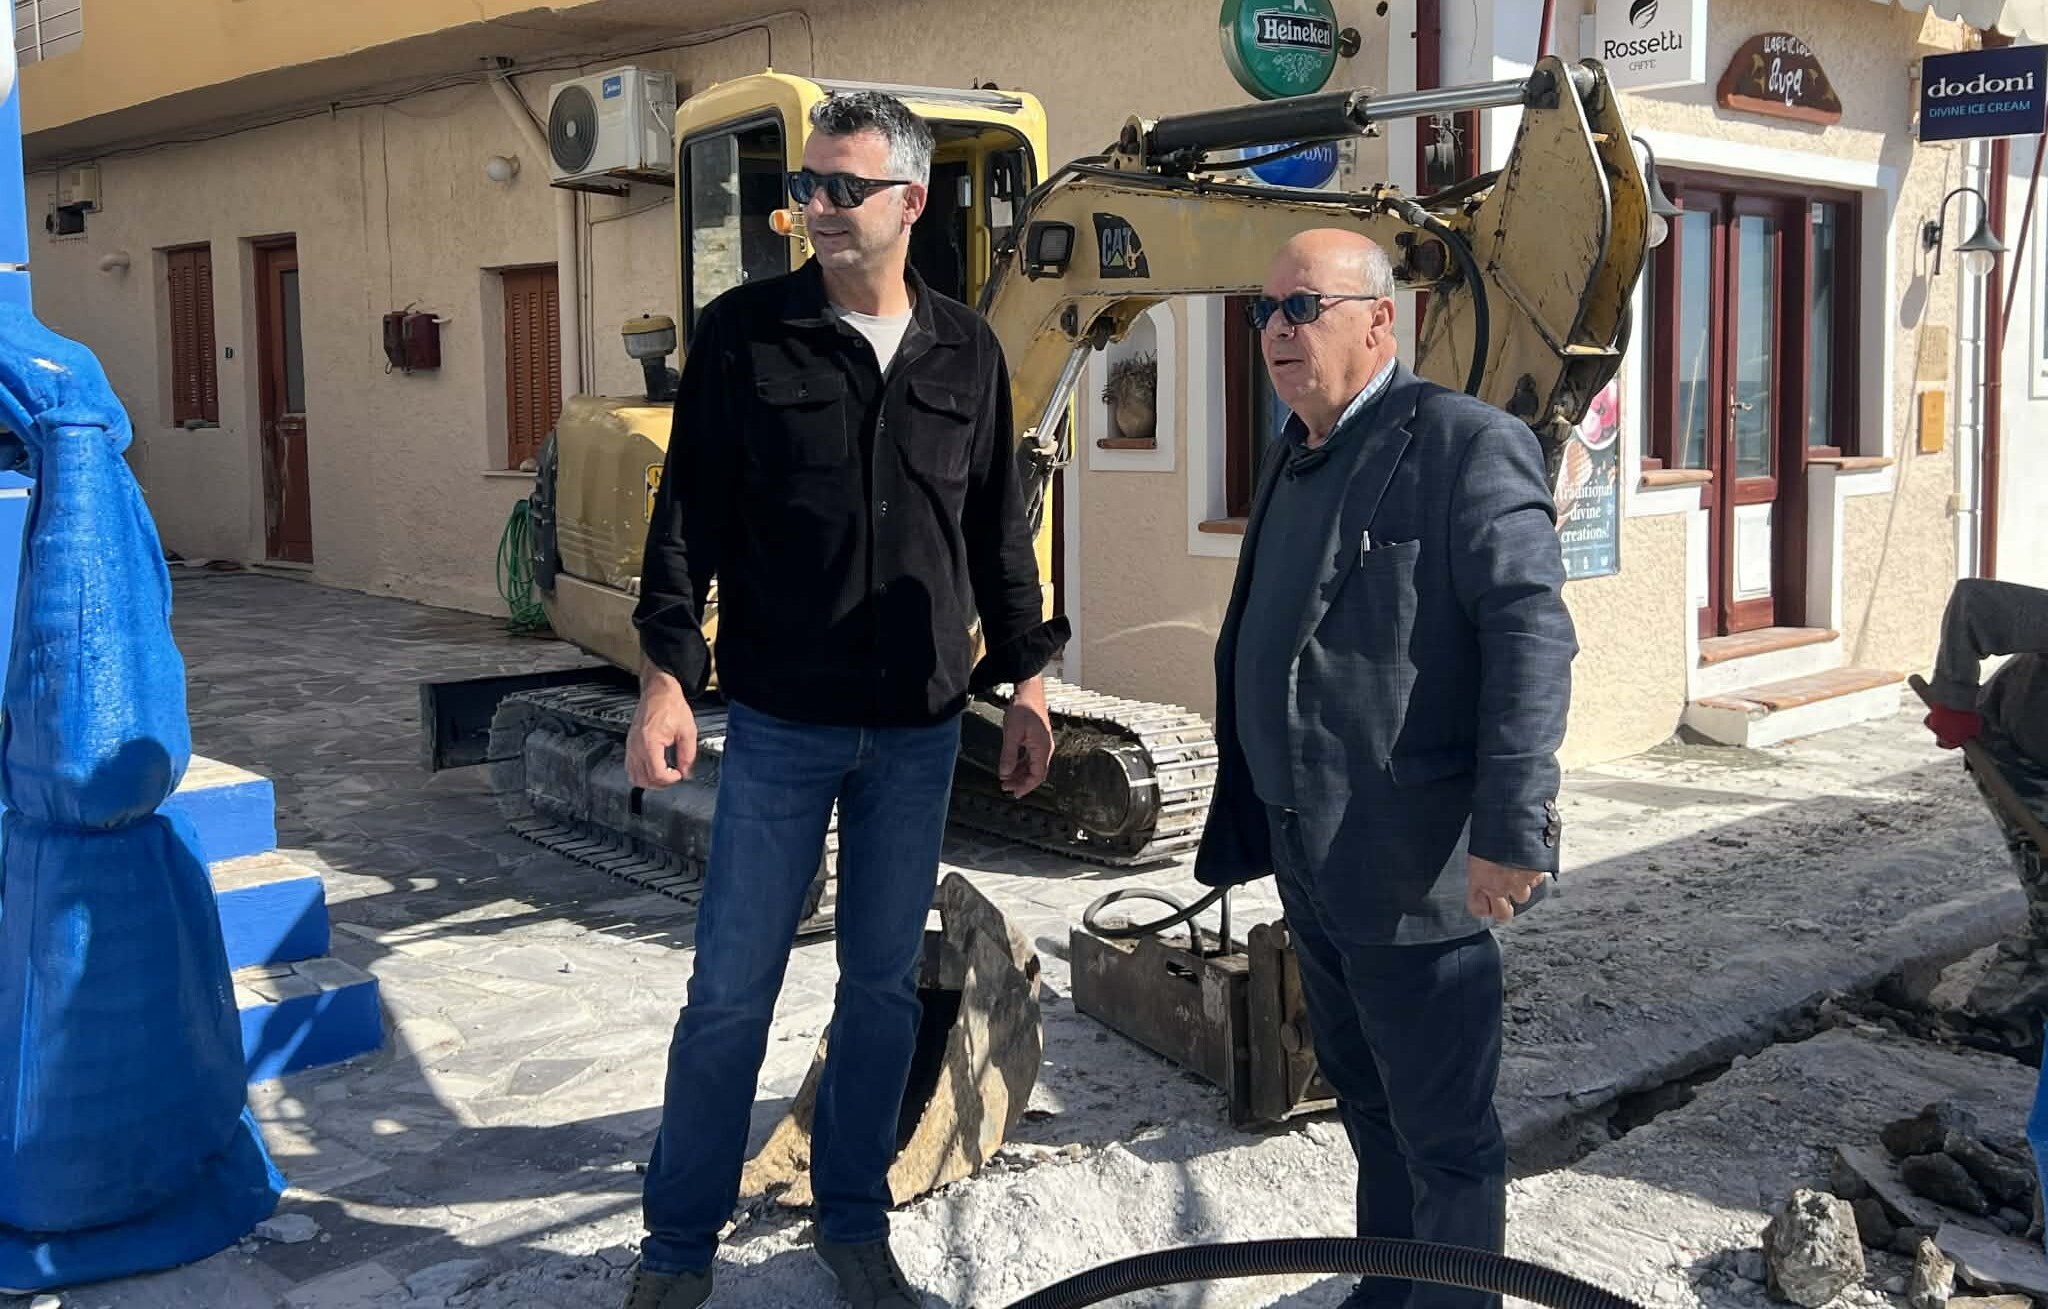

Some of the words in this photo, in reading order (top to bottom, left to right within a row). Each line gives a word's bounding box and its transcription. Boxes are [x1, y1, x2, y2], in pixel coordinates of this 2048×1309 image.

[1263, 18, 1330, 46] Heineken
[1604, 30, 1683, 60] Rossetti
[1927, 72, 2035, 98] dodoni
[1929, 105, 1967, 118] DIVINE
[1968, 102, 1986, 115] ICE
[1987, 100, 2031, 113] CREAM
[1570, 501, 1602, 521] divine
